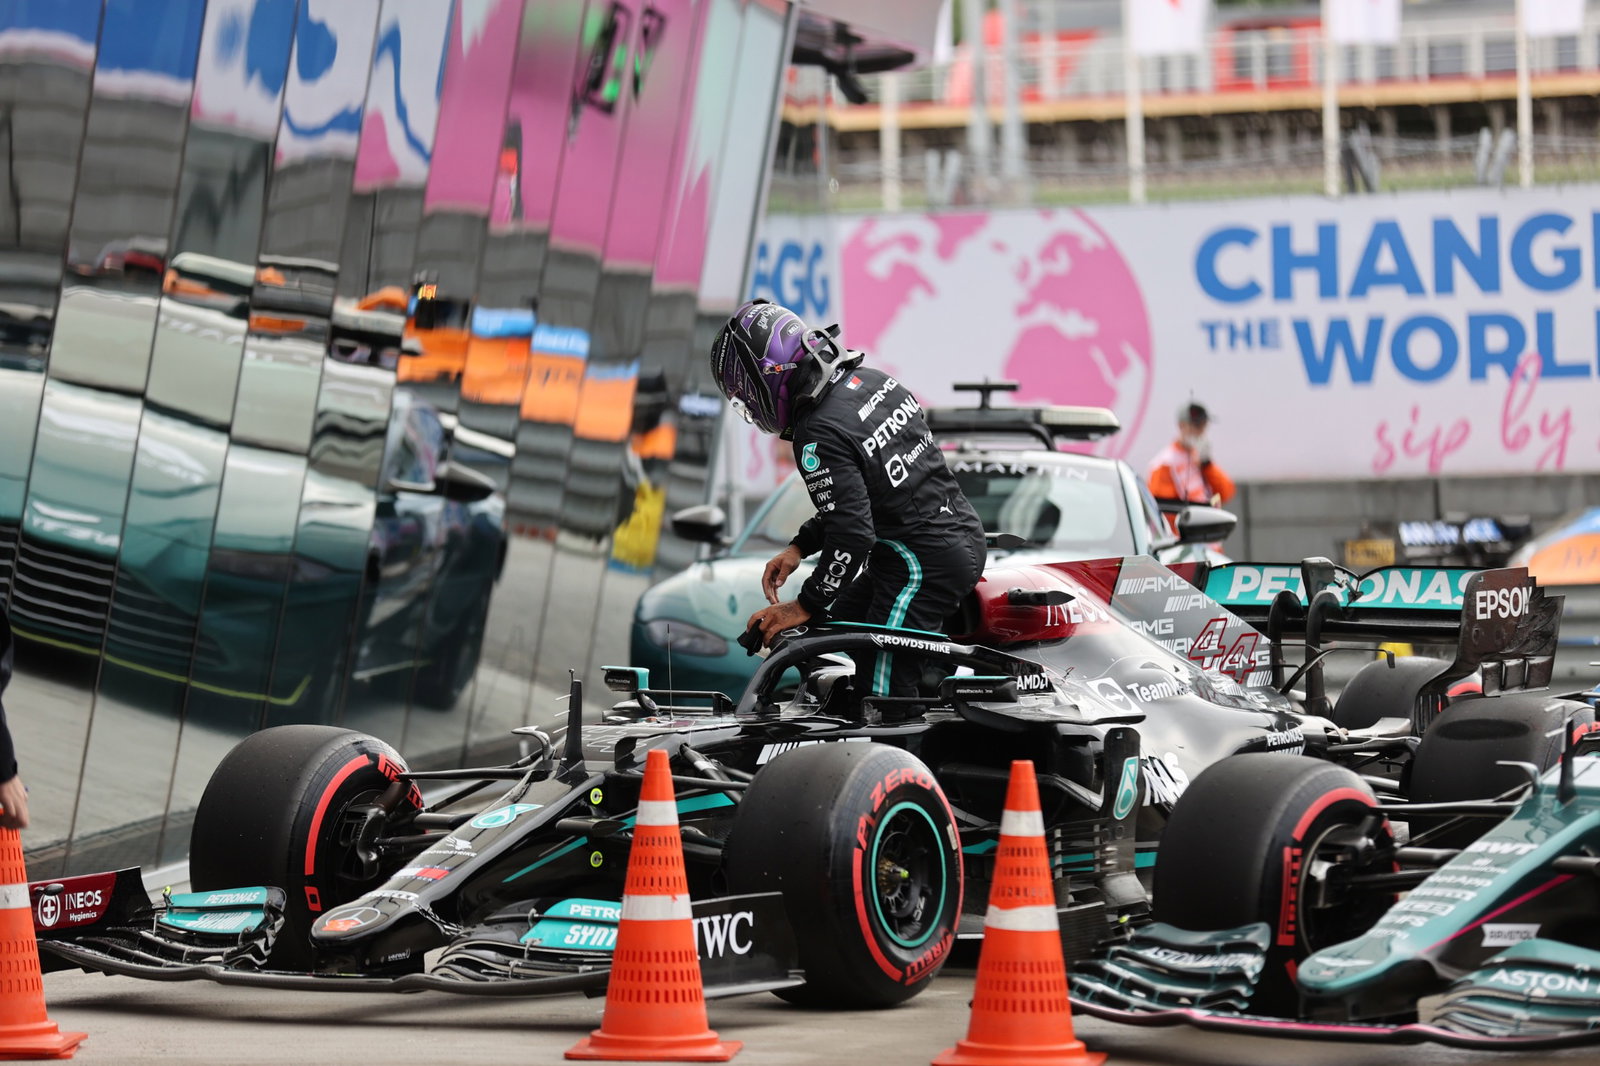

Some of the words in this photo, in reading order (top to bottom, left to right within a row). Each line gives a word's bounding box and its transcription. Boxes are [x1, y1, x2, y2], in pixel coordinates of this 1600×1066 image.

[1196, 210, 1600, 304] CHANG
[1202, 319, 1282, 351] THE
[1292, 311, 1600, 386] WORL
[1372, 403, 1472, 474] sip
[1501, 353, 1574, 472] by
[953, 461, 1089, 481] MARTIN
[807, 476, 834, 493] EPSON
[816, 490, 832, 503] IWC
[1141, 576, 1190, 593] AMG
[1475, 586, 1533, 620] EPSON
[876, 634, 951, 654] CROWDSTRIKE
[1187, 617, 1259, 684] 44
[1016, 674, 1040, 691] AMD
[1266, 728, 1304, 748] PETRONAS
[377, 753, 425, 810] PIRLLI
[870, 767, 934, 814] ZERO
[65, 889, 103, 911] INEOS
[203, 891, 261, 905] PETRONAS
[69, 910, 98, 923] Hygienics
[692, 911, 754, 961] IWC
[905, 928, 955, 986] PIRELLI
[1490, 969, 1589, 993] ASTON
